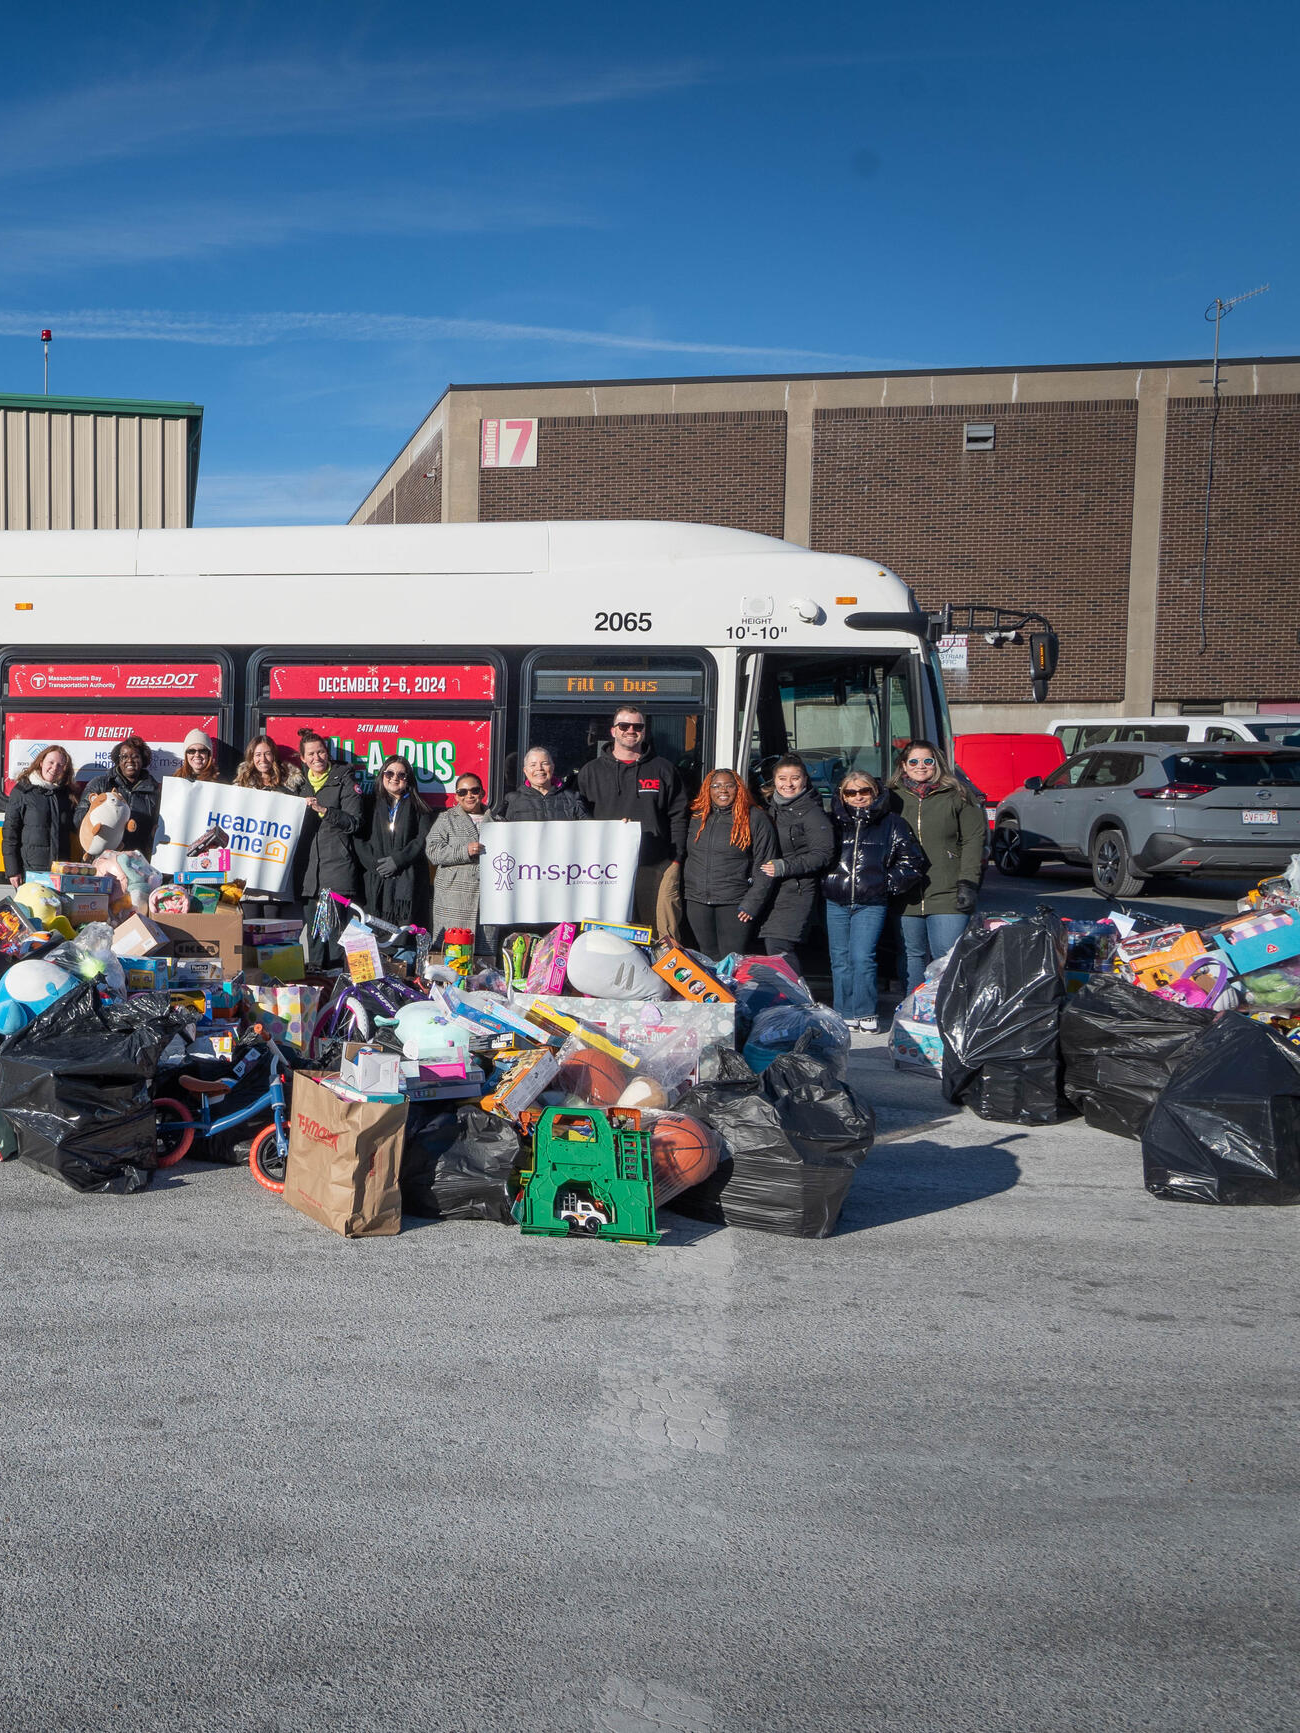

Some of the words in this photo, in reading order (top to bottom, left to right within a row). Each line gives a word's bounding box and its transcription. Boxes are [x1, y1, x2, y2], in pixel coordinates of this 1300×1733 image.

[483, 420, 498, 466] Building
[505, 420, 533, 466] 7
[594, 611, 653, 632] 2065
[741, 617, 773, 625] HEIGHT
[725, 626, 788, 640] 10'-10"
[48, 682, 89, 690] Transportation
[90, 682, 116, 690] Authority
[126, 673, 199, 686] massDOT
[318, 677, 380, 693] DECEMBER
[414, 677, 446, 693] 2024
[567, 677, 595, 692] Fill
[603, 680, 615, 692] a
[623, 677, 658, 692] bus
[84, 726, 95, 738] TO
[356, 723, 374, 733] 24TH
[374, 724, 400, 734] ANNUAL
[562, 923, 574, 940] Barbie
[178, 945, 216, 954] IKEA
